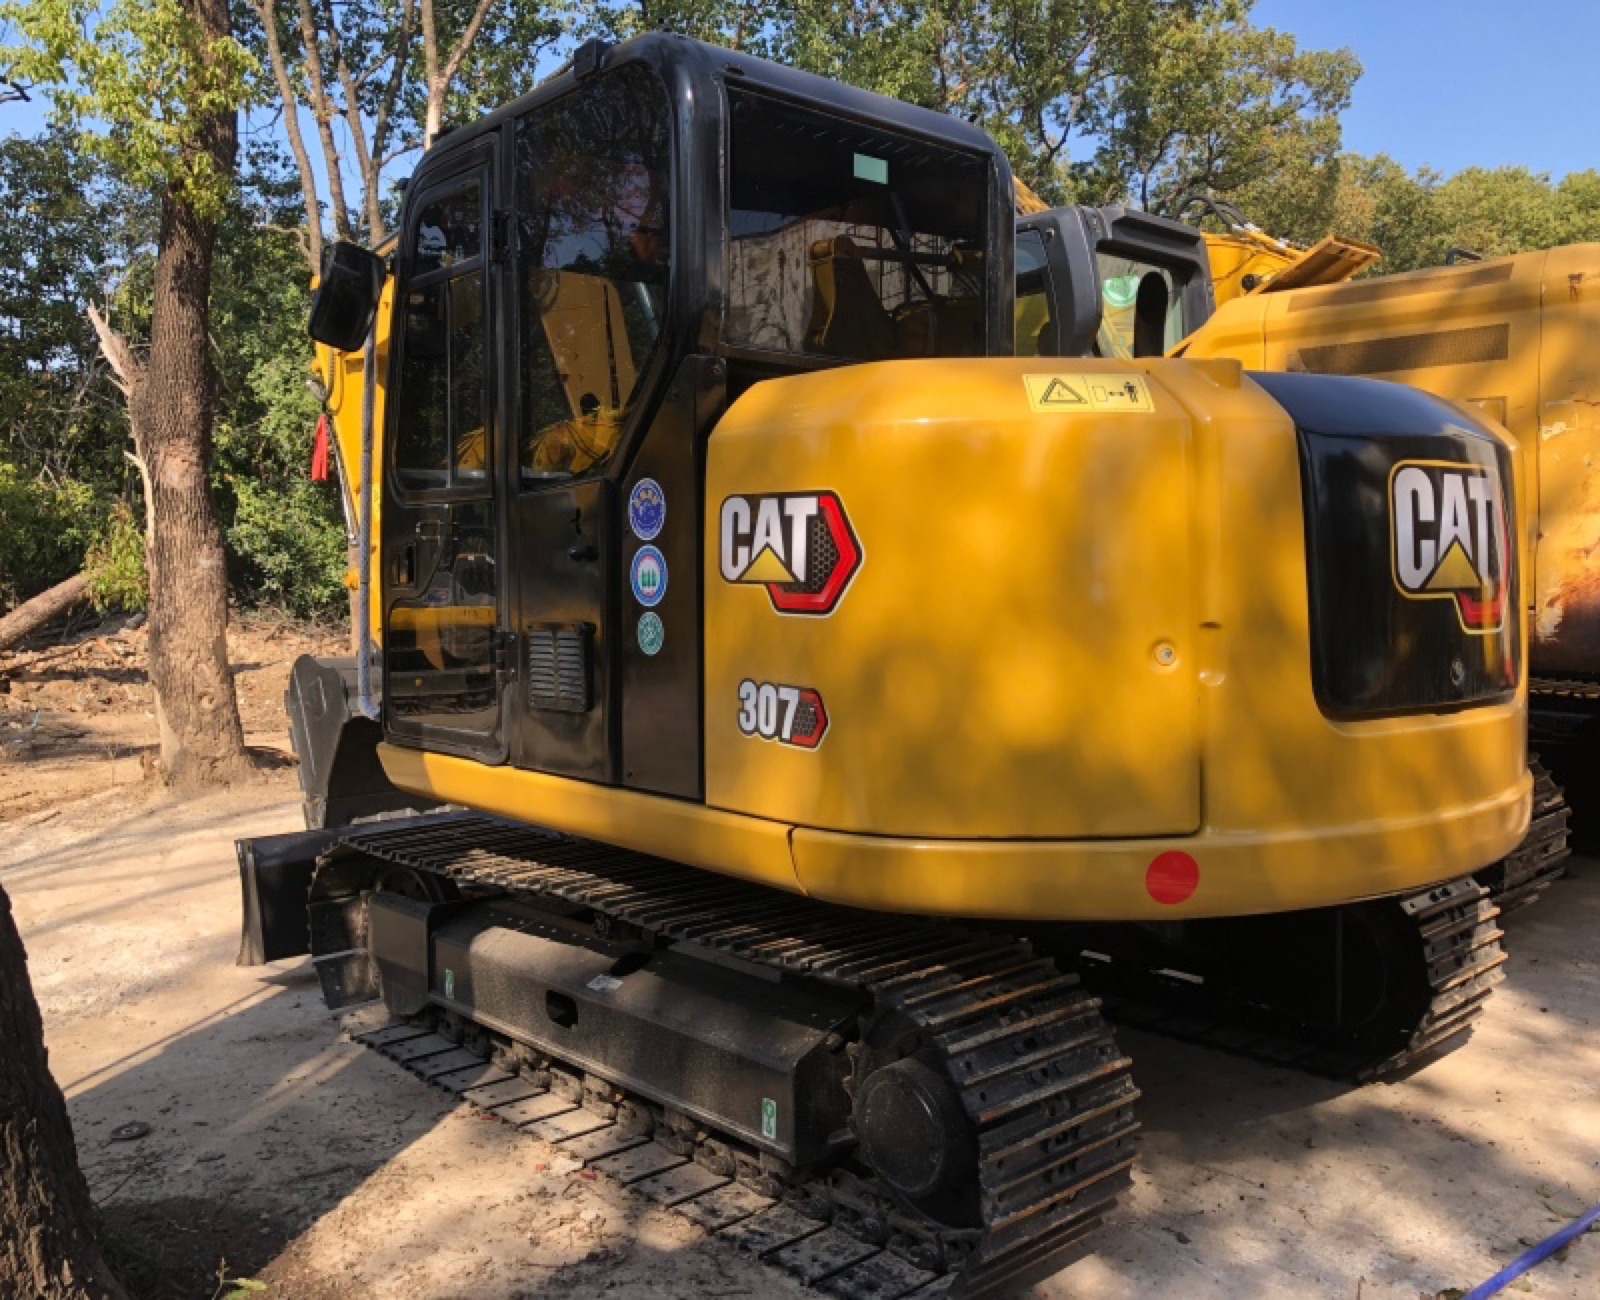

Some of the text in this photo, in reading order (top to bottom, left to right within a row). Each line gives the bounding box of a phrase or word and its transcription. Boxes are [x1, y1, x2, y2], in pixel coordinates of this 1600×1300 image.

[721, 496, 818, 582] CAT
[1395, 467, 1492, 589] CAT
[739, 681, 800, 740] 307
